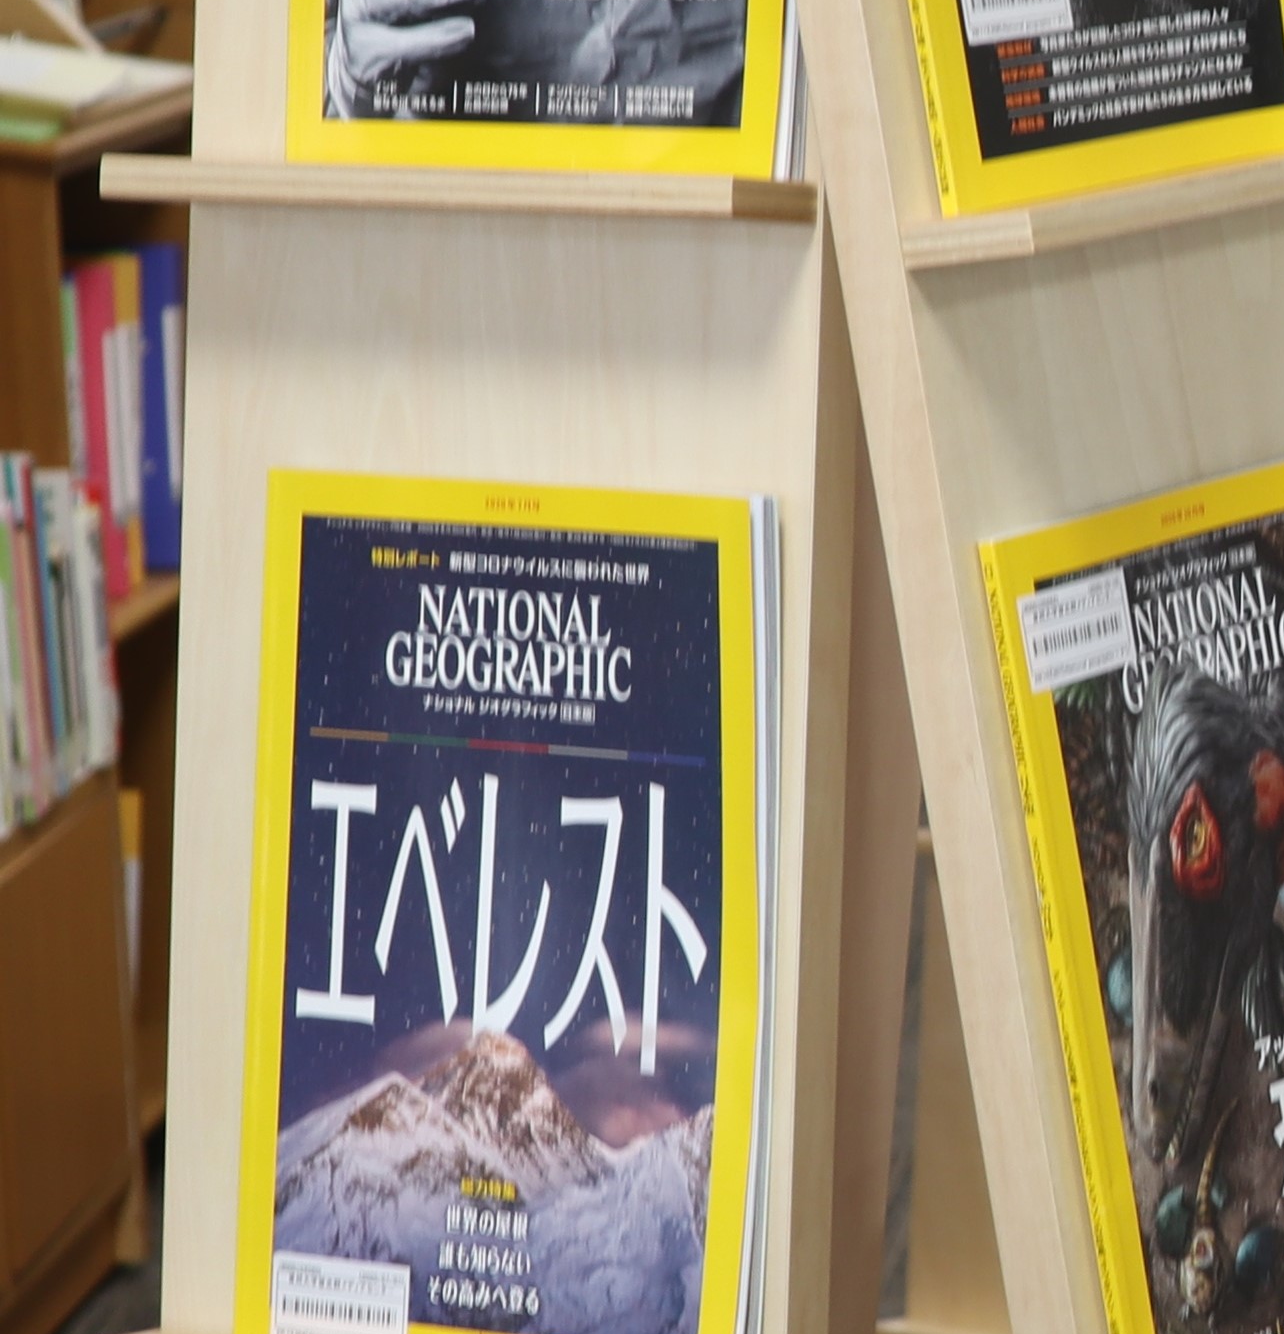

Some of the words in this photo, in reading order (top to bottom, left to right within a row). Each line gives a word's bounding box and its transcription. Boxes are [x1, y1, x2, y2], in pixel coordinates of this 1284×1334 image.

[417, 582, 612, 649] NATIONAL
[1133, 566, 1276, 655] NATIONAL
[384, 630, 633, 704] GEOGRAPHIC
[295, 772, 709, 1078] エベレスト
[446, 1203, 528, 1242] 世界の屋根
[438, 1238, 531, 1277] 誰も知らない
[427, 1274, 540, 1317] その高みへ登る
